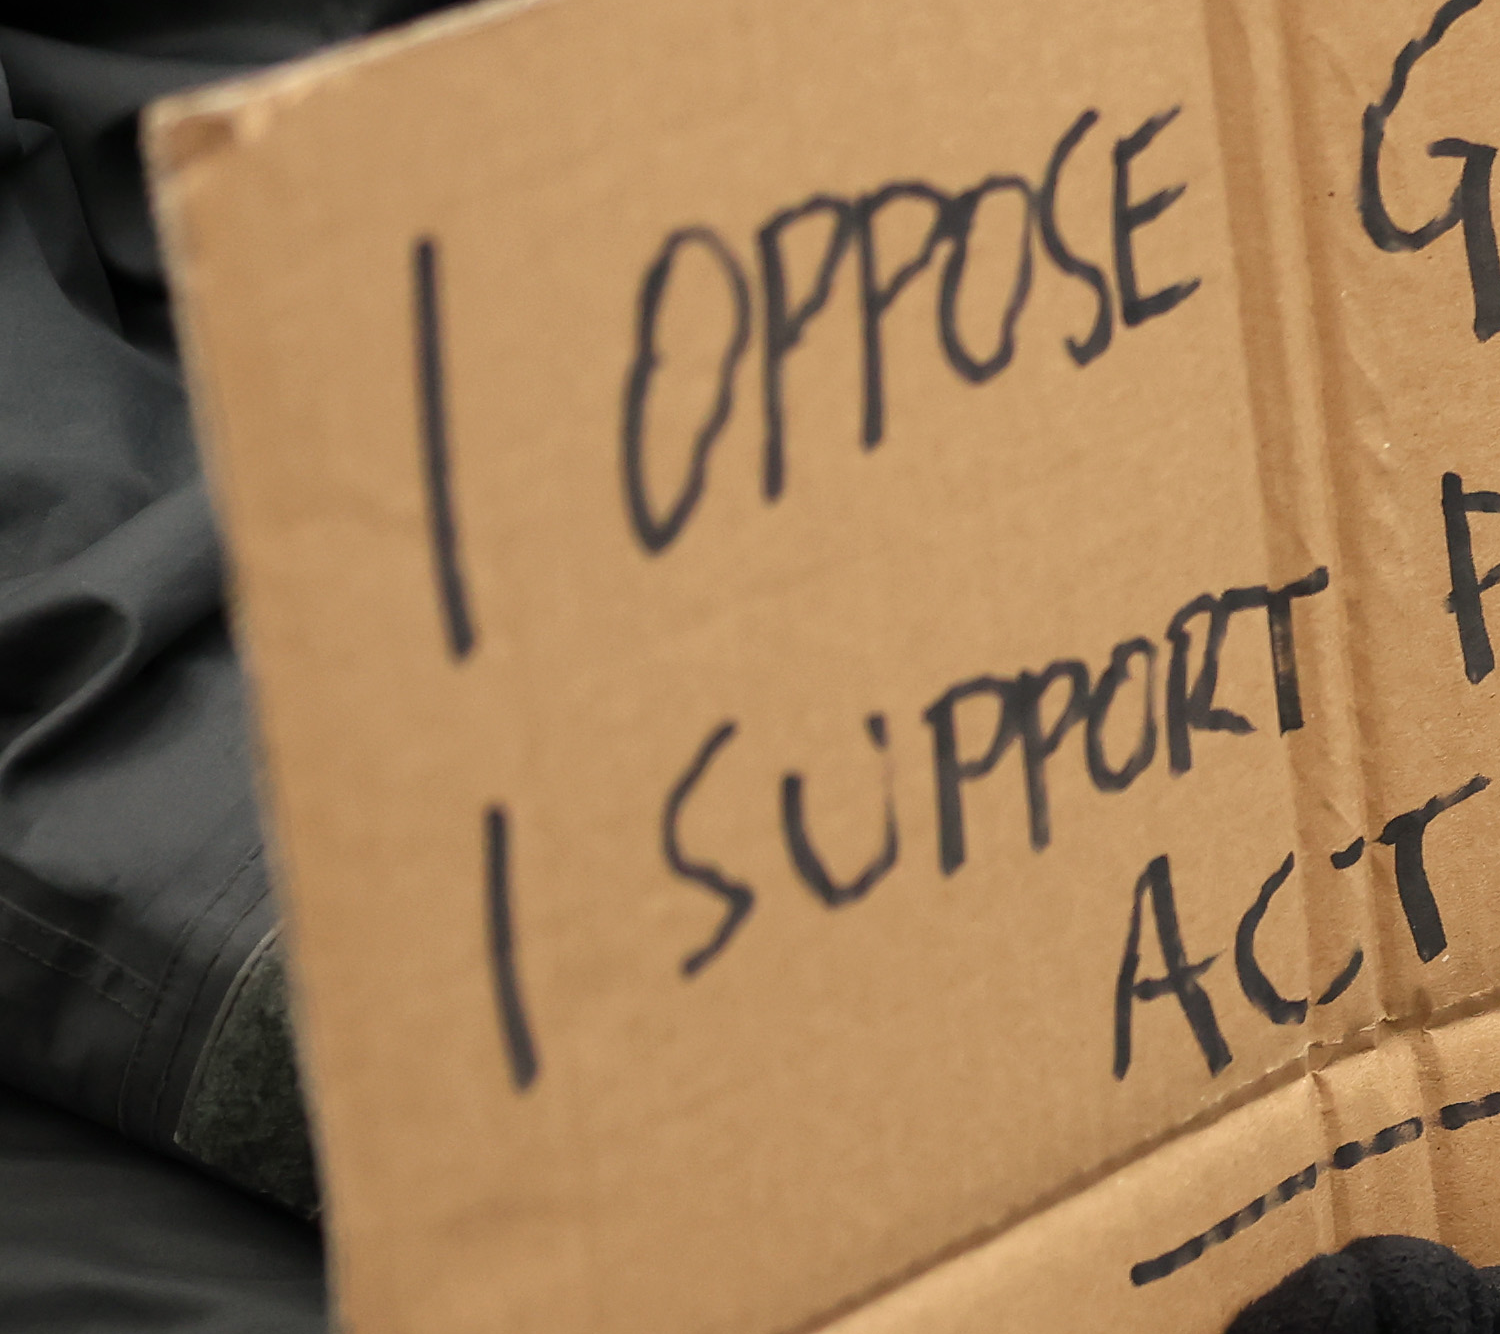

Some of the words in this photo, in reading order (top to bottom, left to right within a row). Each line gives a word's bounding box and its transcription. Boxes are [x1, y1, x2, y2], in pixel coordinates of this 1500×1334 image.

[414, 238, 473, 654] I
[619, 105, 1204, 553] OPPOSE
[489, 804, 540, 1089] I
[662, 568, 1331, 975] SUPPORT
